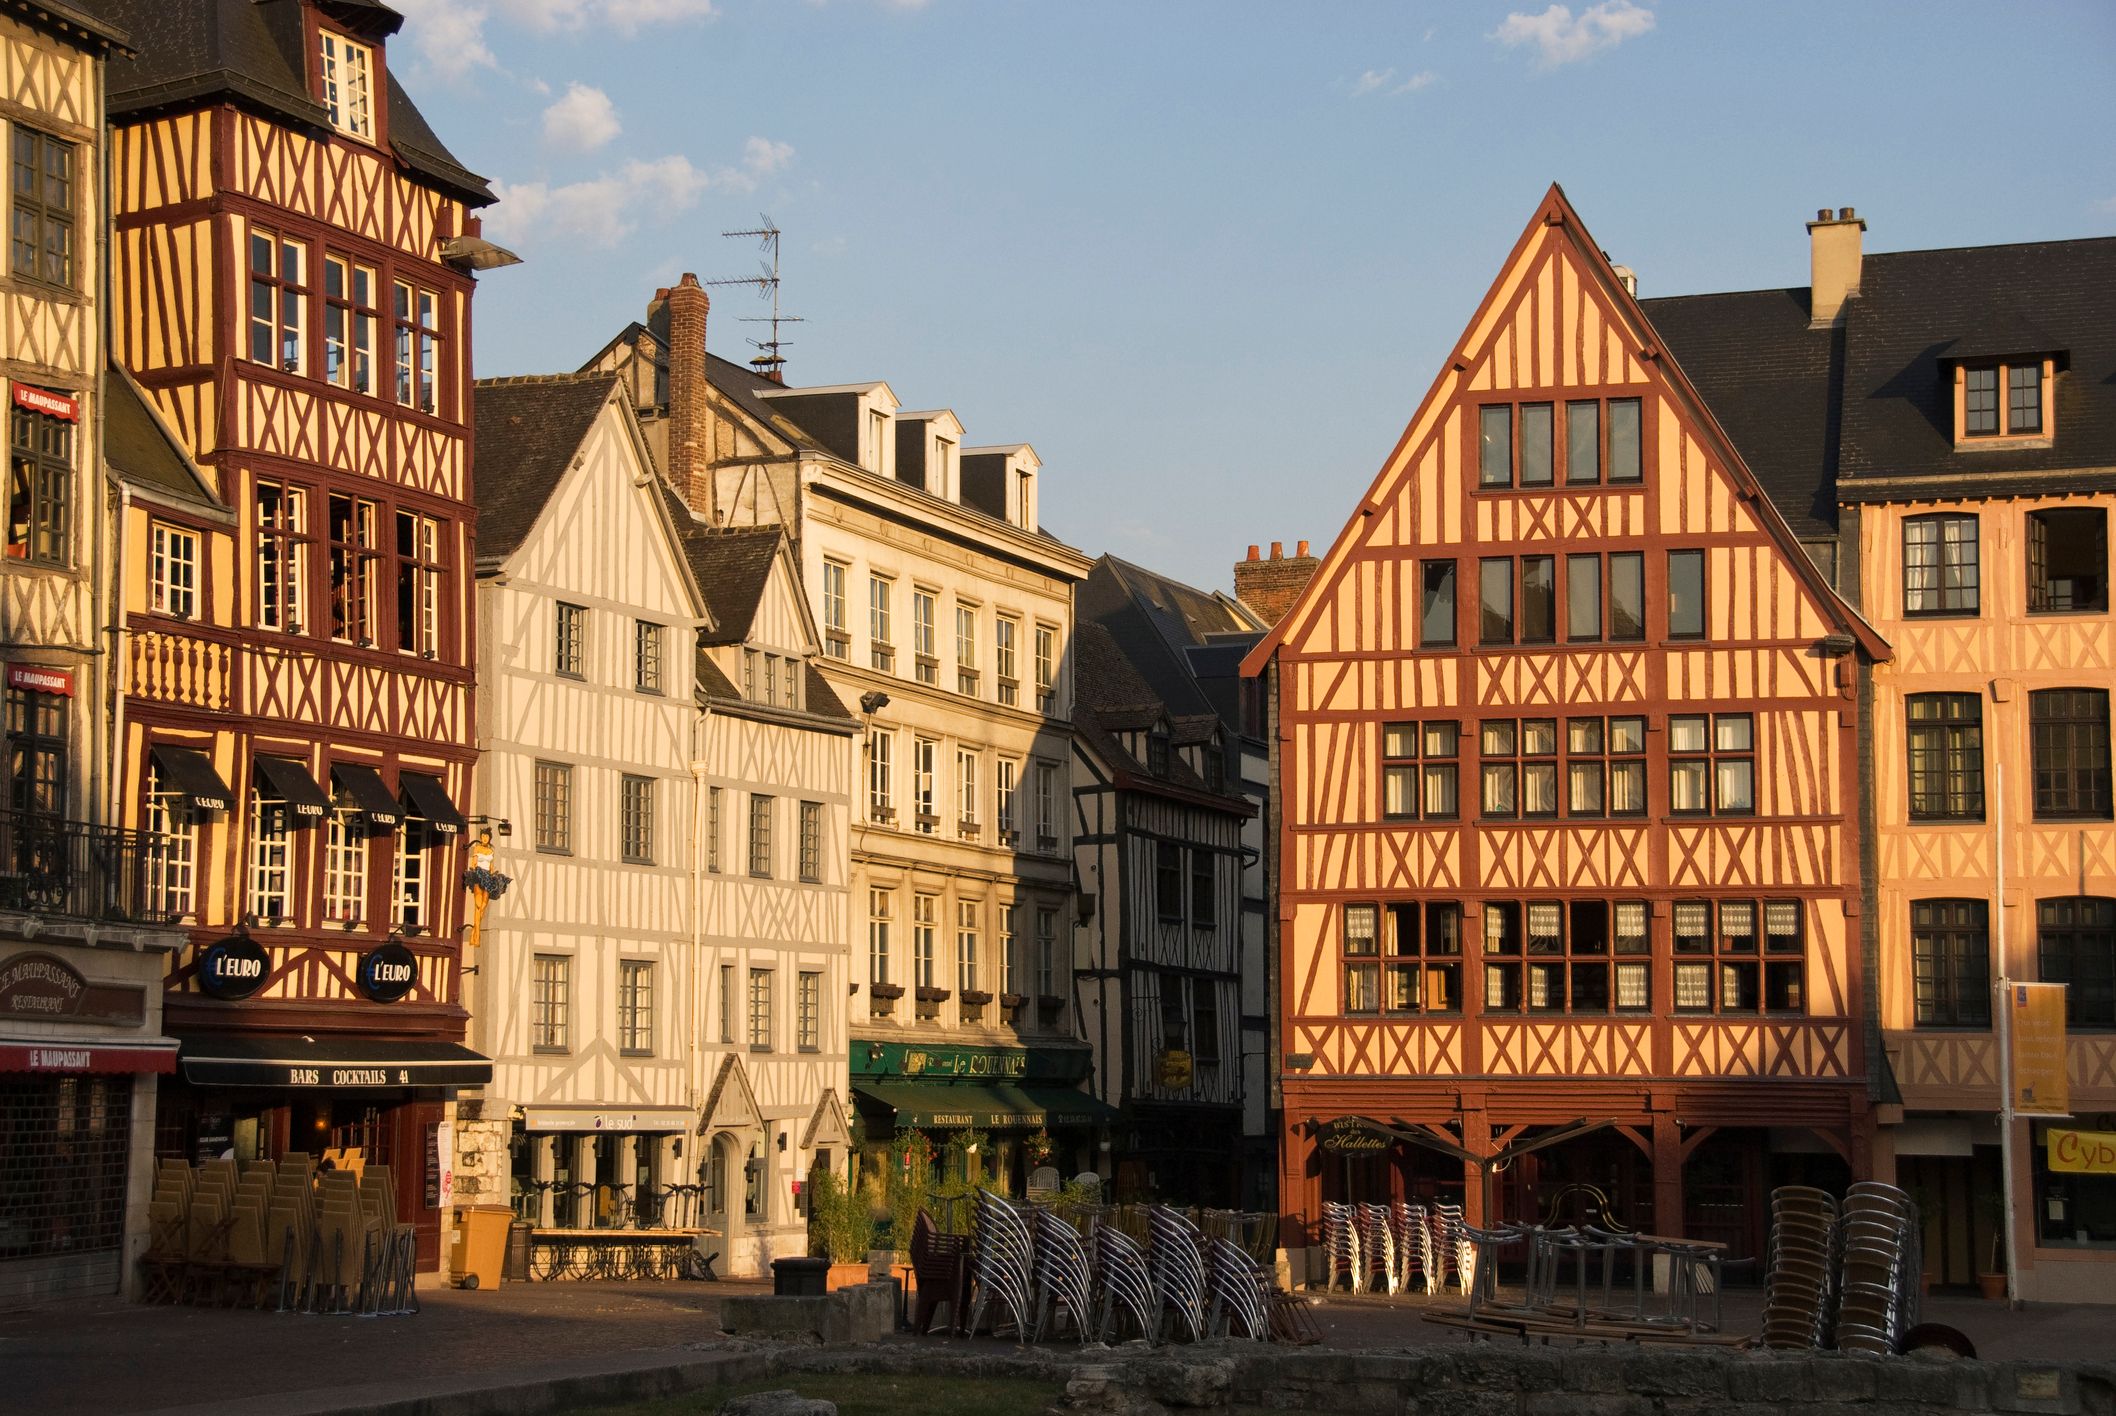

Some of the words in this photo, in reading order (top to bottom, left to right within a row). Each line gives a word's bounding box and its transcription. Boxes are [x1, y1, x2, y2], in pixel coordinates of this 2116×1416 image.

[20, 389, 28, 402] LE
[28, 392, 71, 415] MAUPASSANT
[15, 671, 23, 682] LE
[23, 672, 66, 689] MAUPASSANT
[215, 954, 262, 978] L'EURO
[374, 961, 411, 982] L'EURO
[11, 962, 81, 999] MAUPASSANT
[11, 994, 65, 1013] RESTAURANT
[30, 1049, 39, 1067] LE
[40, 1050, 91, 1068] MAUPASSANT
[953, 1054, 966, 1074] Le
[290, 1068, 319, 1085] BARS
[333, 1069, 387, 1085] COCKTAILS
[399, 1069, 409, 1084] 41
[605, 1114, 614, 1130] le
[617, 1114, 633, 1130] sud
[933, 1114, 974, 1125] RESTAURANT
[990, 1114, 1000, 1124] LE
[1003, 1114, 1043, 1125] ROUENNAIS
